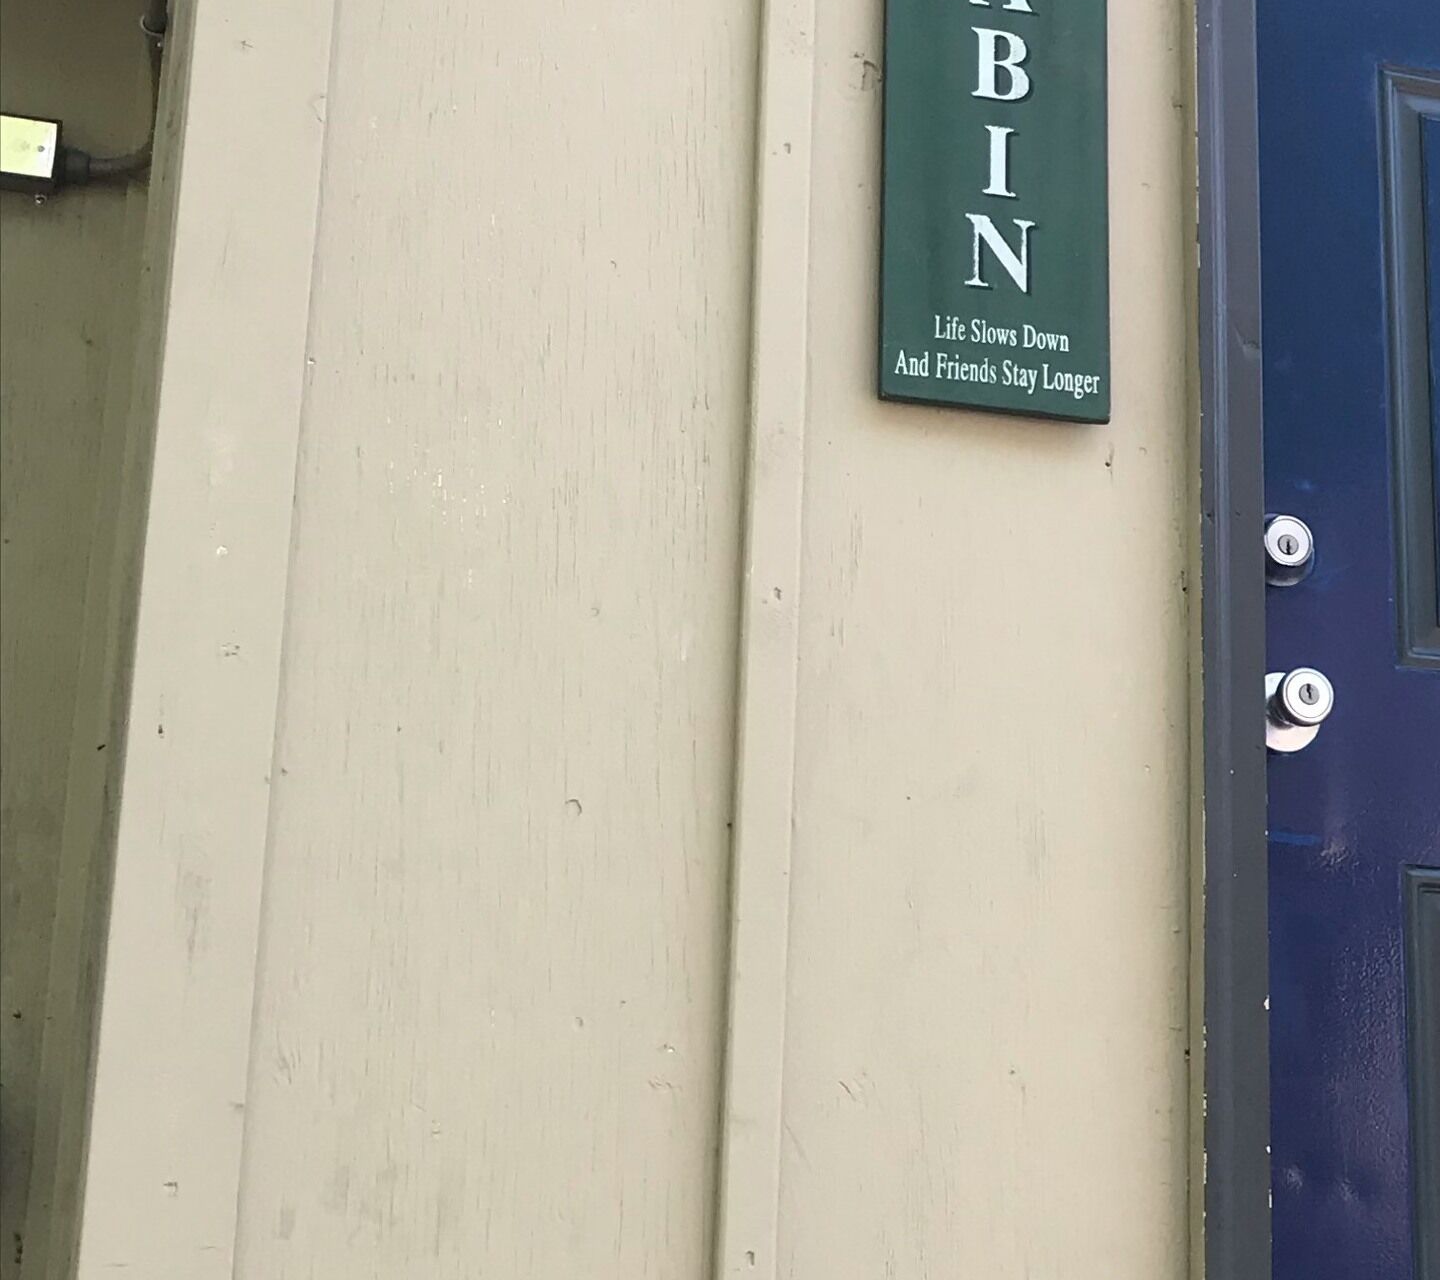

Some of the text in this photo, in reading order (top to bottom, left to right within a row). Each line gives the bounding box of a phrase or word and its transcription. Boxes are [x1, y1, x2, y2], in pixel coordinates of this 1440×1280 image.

[934, 315, 1069, 352] Life Slows Down
[895, 350, 1100, 399] And Friends Stay Longer
